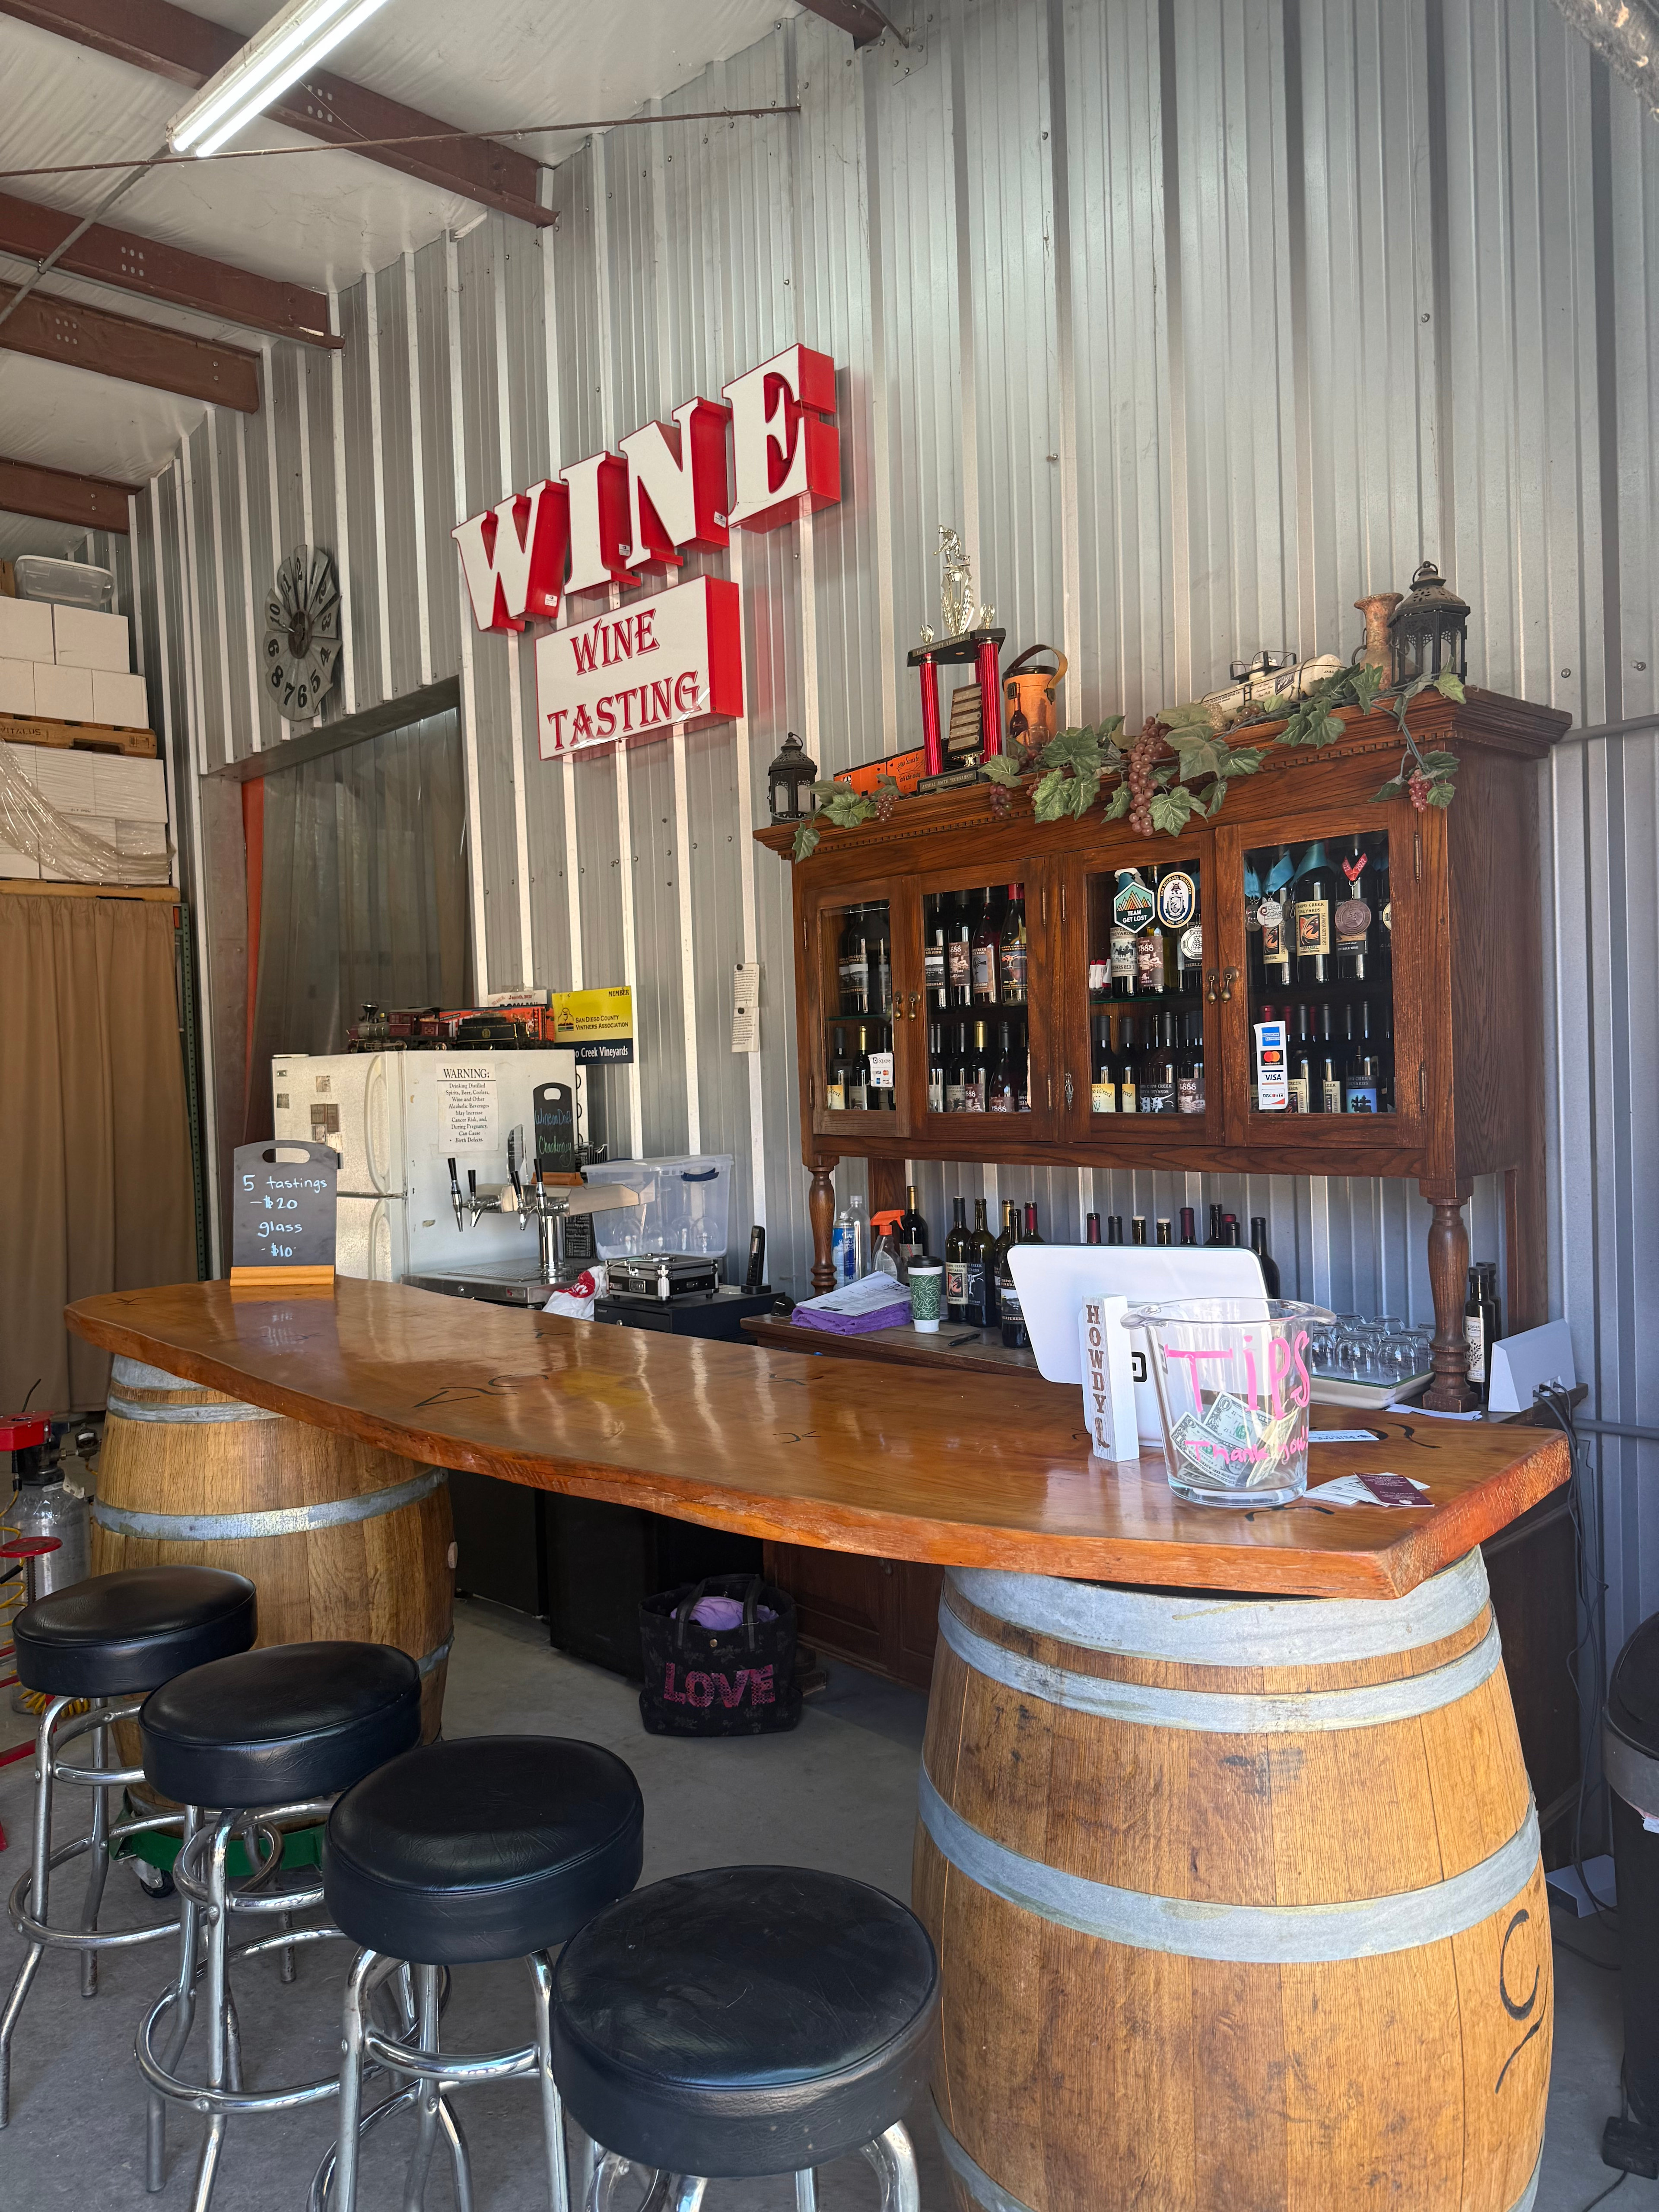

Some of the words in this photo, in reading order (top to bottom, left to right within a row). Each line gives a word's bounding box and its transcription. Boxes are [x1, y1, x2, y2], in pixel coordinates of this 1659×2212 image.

[451, 343, 809, 632] WINE
[322, 612, 331, 632] 3
[569, 608, 660, 676] WINE
[928, 642, 944, 652] COUNTY
[320, 647, 331, 667] 4
[271, 665, 283, 688] 8
[310, 669, 321, 693] 5
[283, 682, 295, 706] 7
[298, 684, 307, 708] 6
[547, 671, 702, 751] TASTING
[608, 989, 629, 998] MEMBER
[581, 1047, 598, 1058] Creek
[599, 1045, 628, 1058] Vineyards
[443, 1068, 489, 1079] WARNING:
[966, 1089, 976, 1097] 888
[534, 1108, 552, 1125] Wine
[242, 1174, 256, 1192] 5
[266, 1175, 327, 1194] tastings
[257, 1221, 303, 1238] glass
[1085, 1303, 1107, 1415] HOWDY
[1184, 1440, 1269, 1464] Thank
[663, 1662, 776, 1708] LOVE
